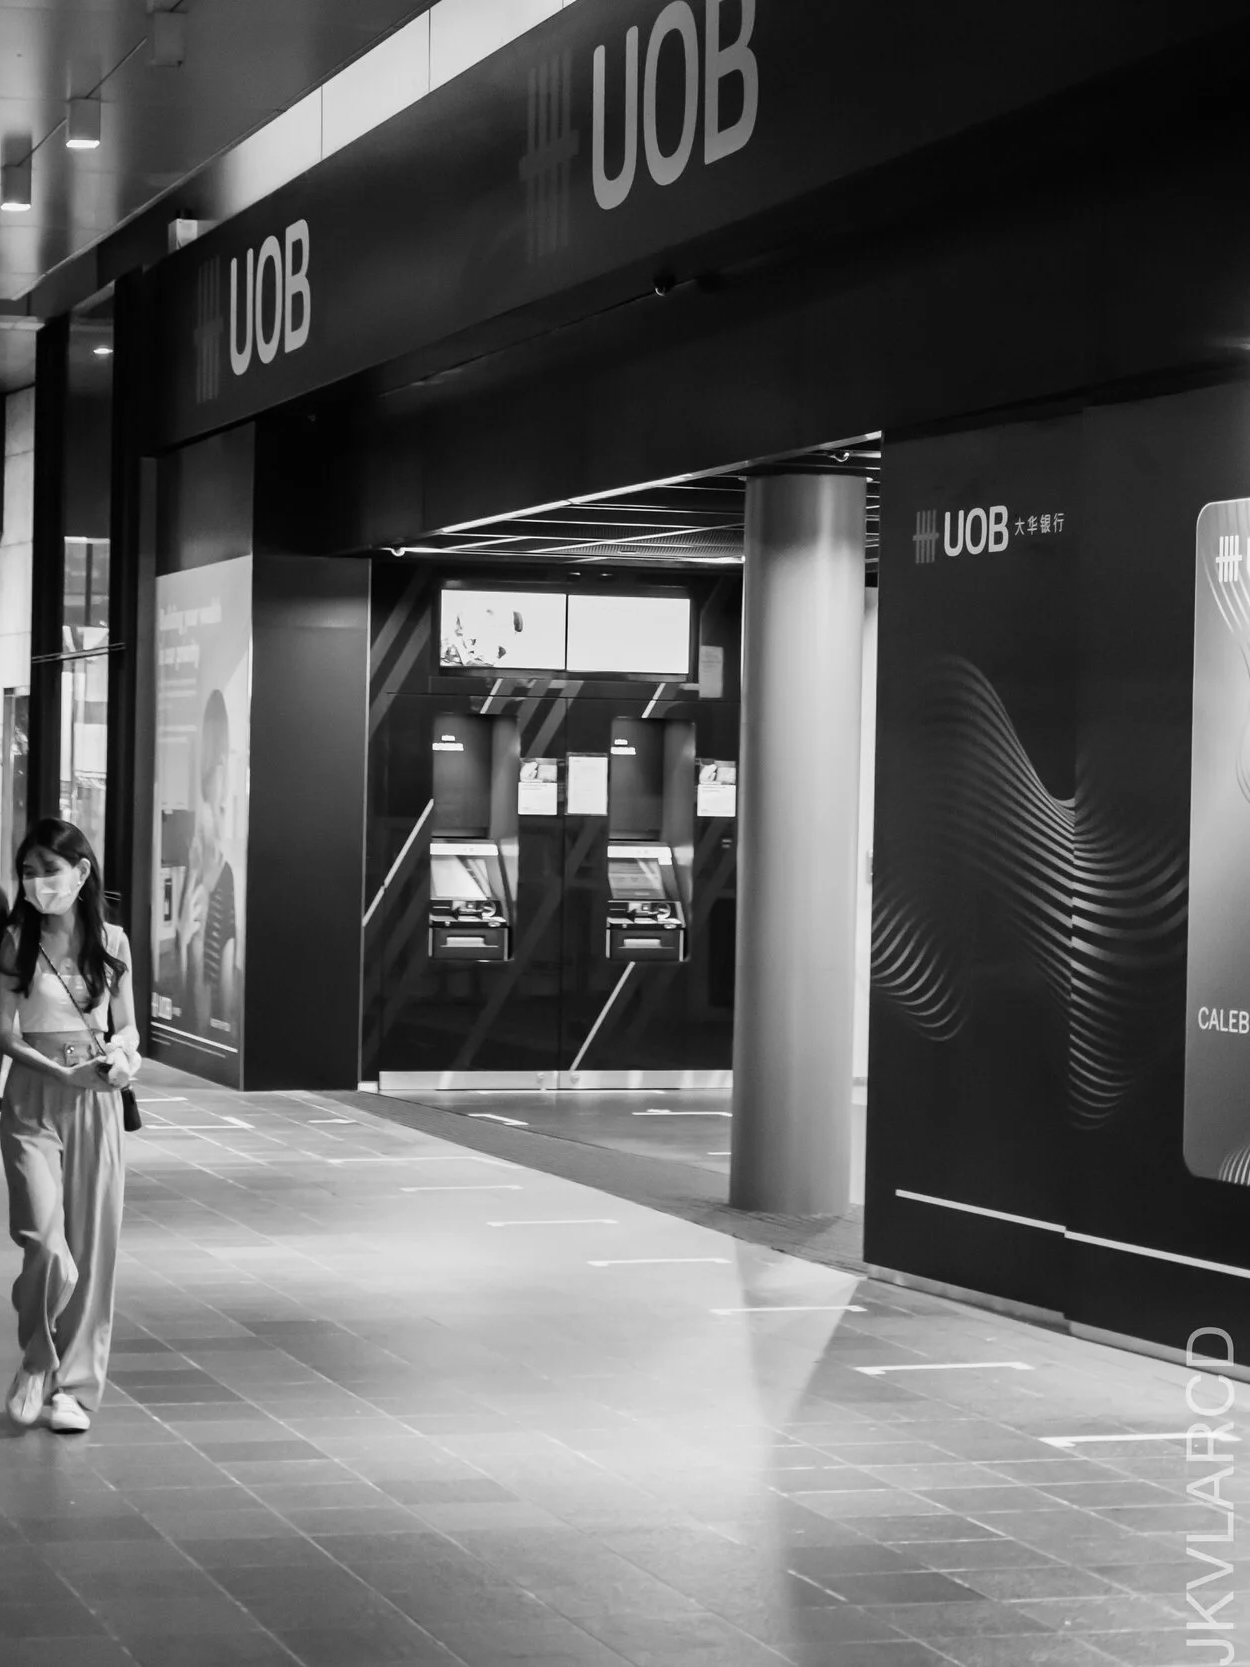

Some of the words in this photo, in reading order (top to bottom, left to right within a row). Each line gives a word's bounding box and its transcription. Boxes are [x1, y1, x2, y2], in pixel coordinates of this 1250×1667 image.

[592, 0, 759, 211] UOB
[229, 218, 311, 376] UOB
[944, 505, 1009, 557] UOB
[1014, 513, 1065, 536] 大华银行
[1198, 1006, 1250, 1034] CALEB
